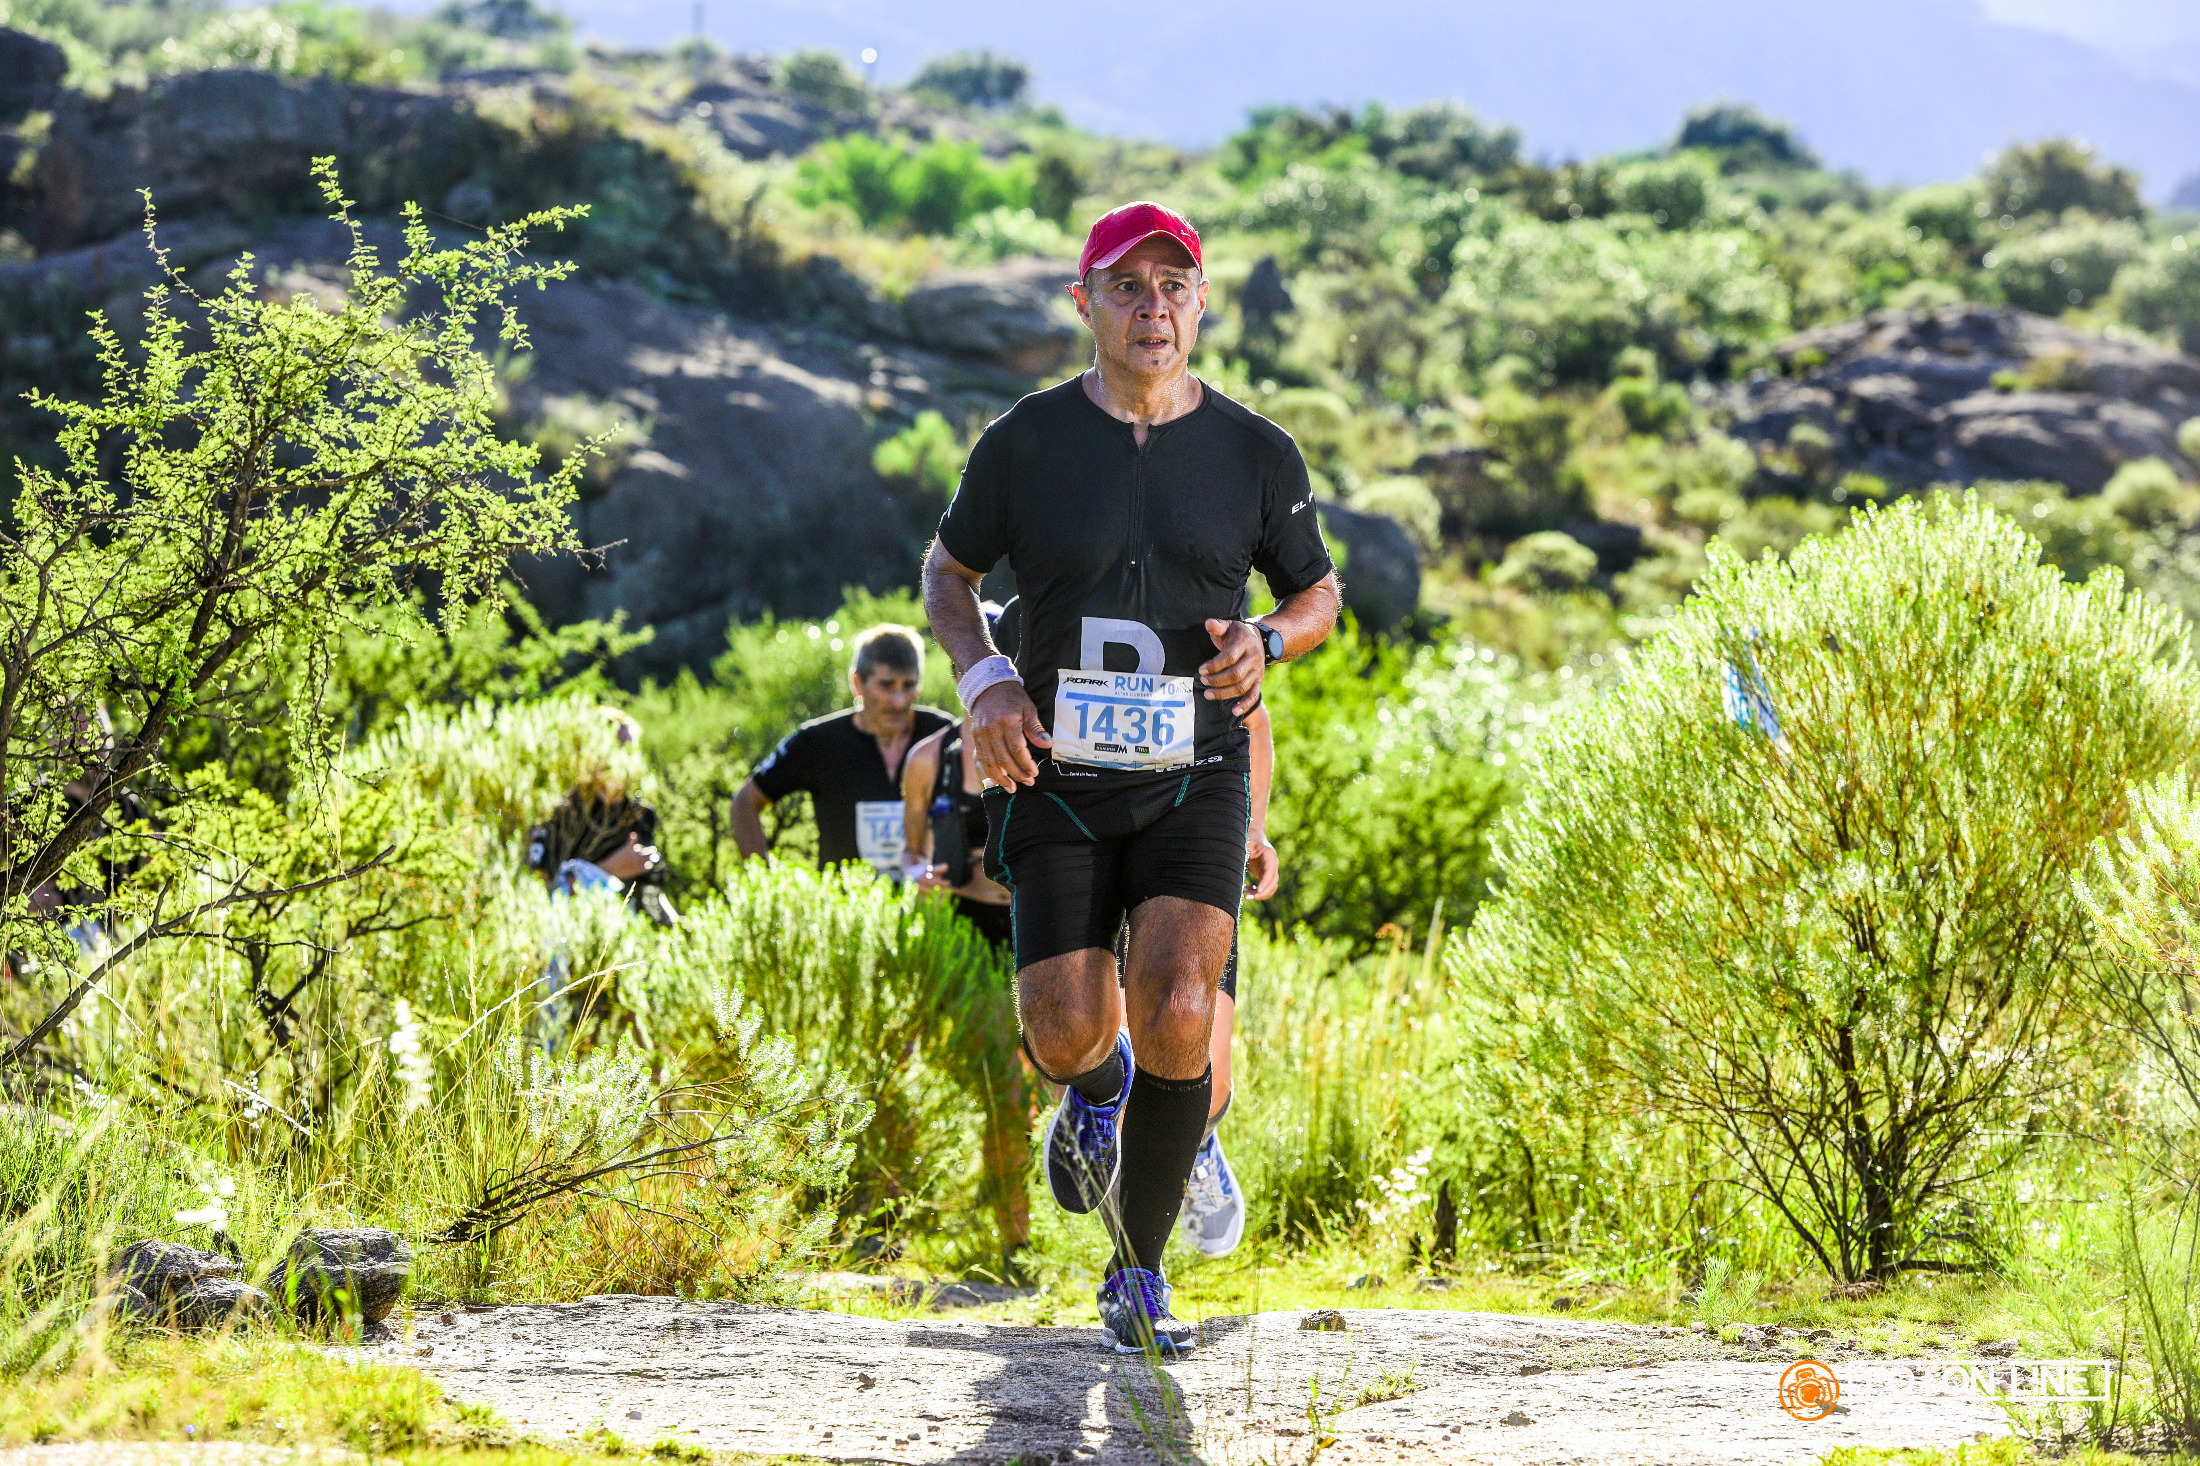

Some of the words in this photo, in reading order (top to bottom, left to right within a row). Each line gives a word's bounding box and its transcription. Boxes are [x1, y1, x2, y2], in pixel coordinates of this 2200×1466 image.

[1114, 675, 1154, 693] RUN
[1160, 682, 1176, 696] 10
[1074, 702, 1175, 746] 1436
